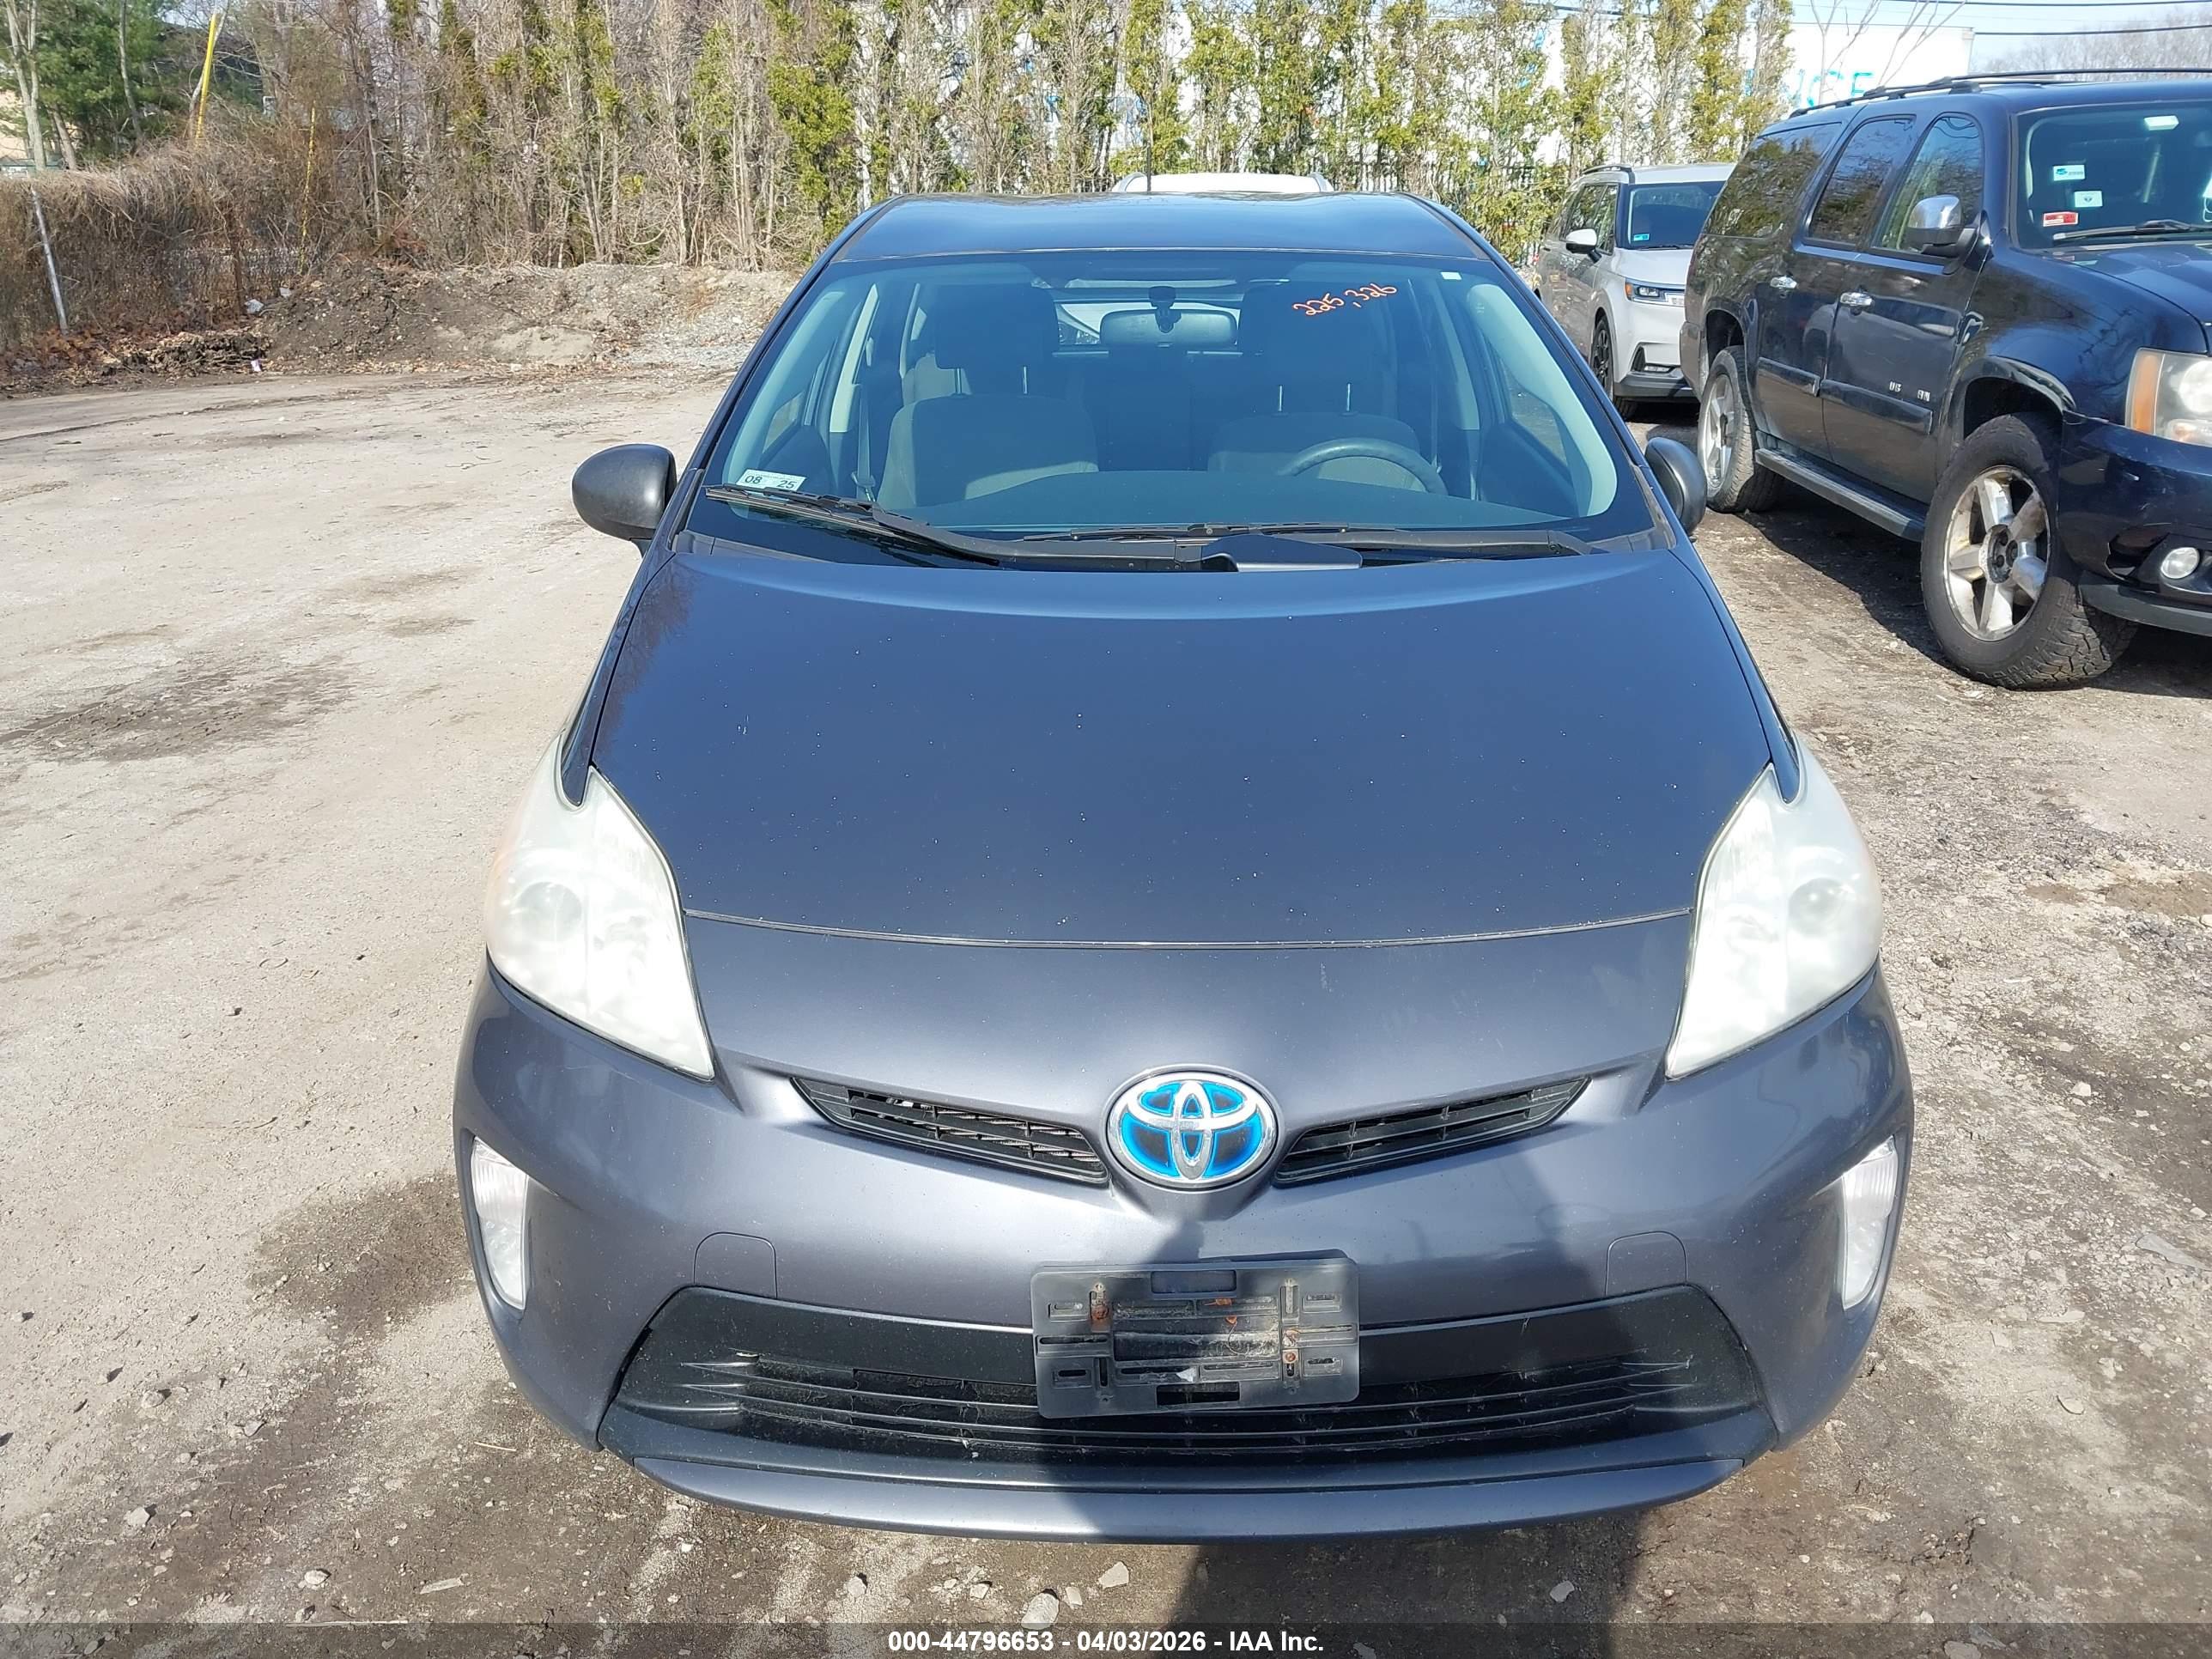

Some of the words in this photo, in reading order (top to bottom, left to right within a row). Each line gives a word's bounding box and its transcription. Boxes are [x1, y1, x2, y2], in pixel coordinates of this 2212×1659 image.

[1292, 283, 1398, 316] 225,326
[744, 475, 763, 484] 08
[776, 479, 798, 489] 25
